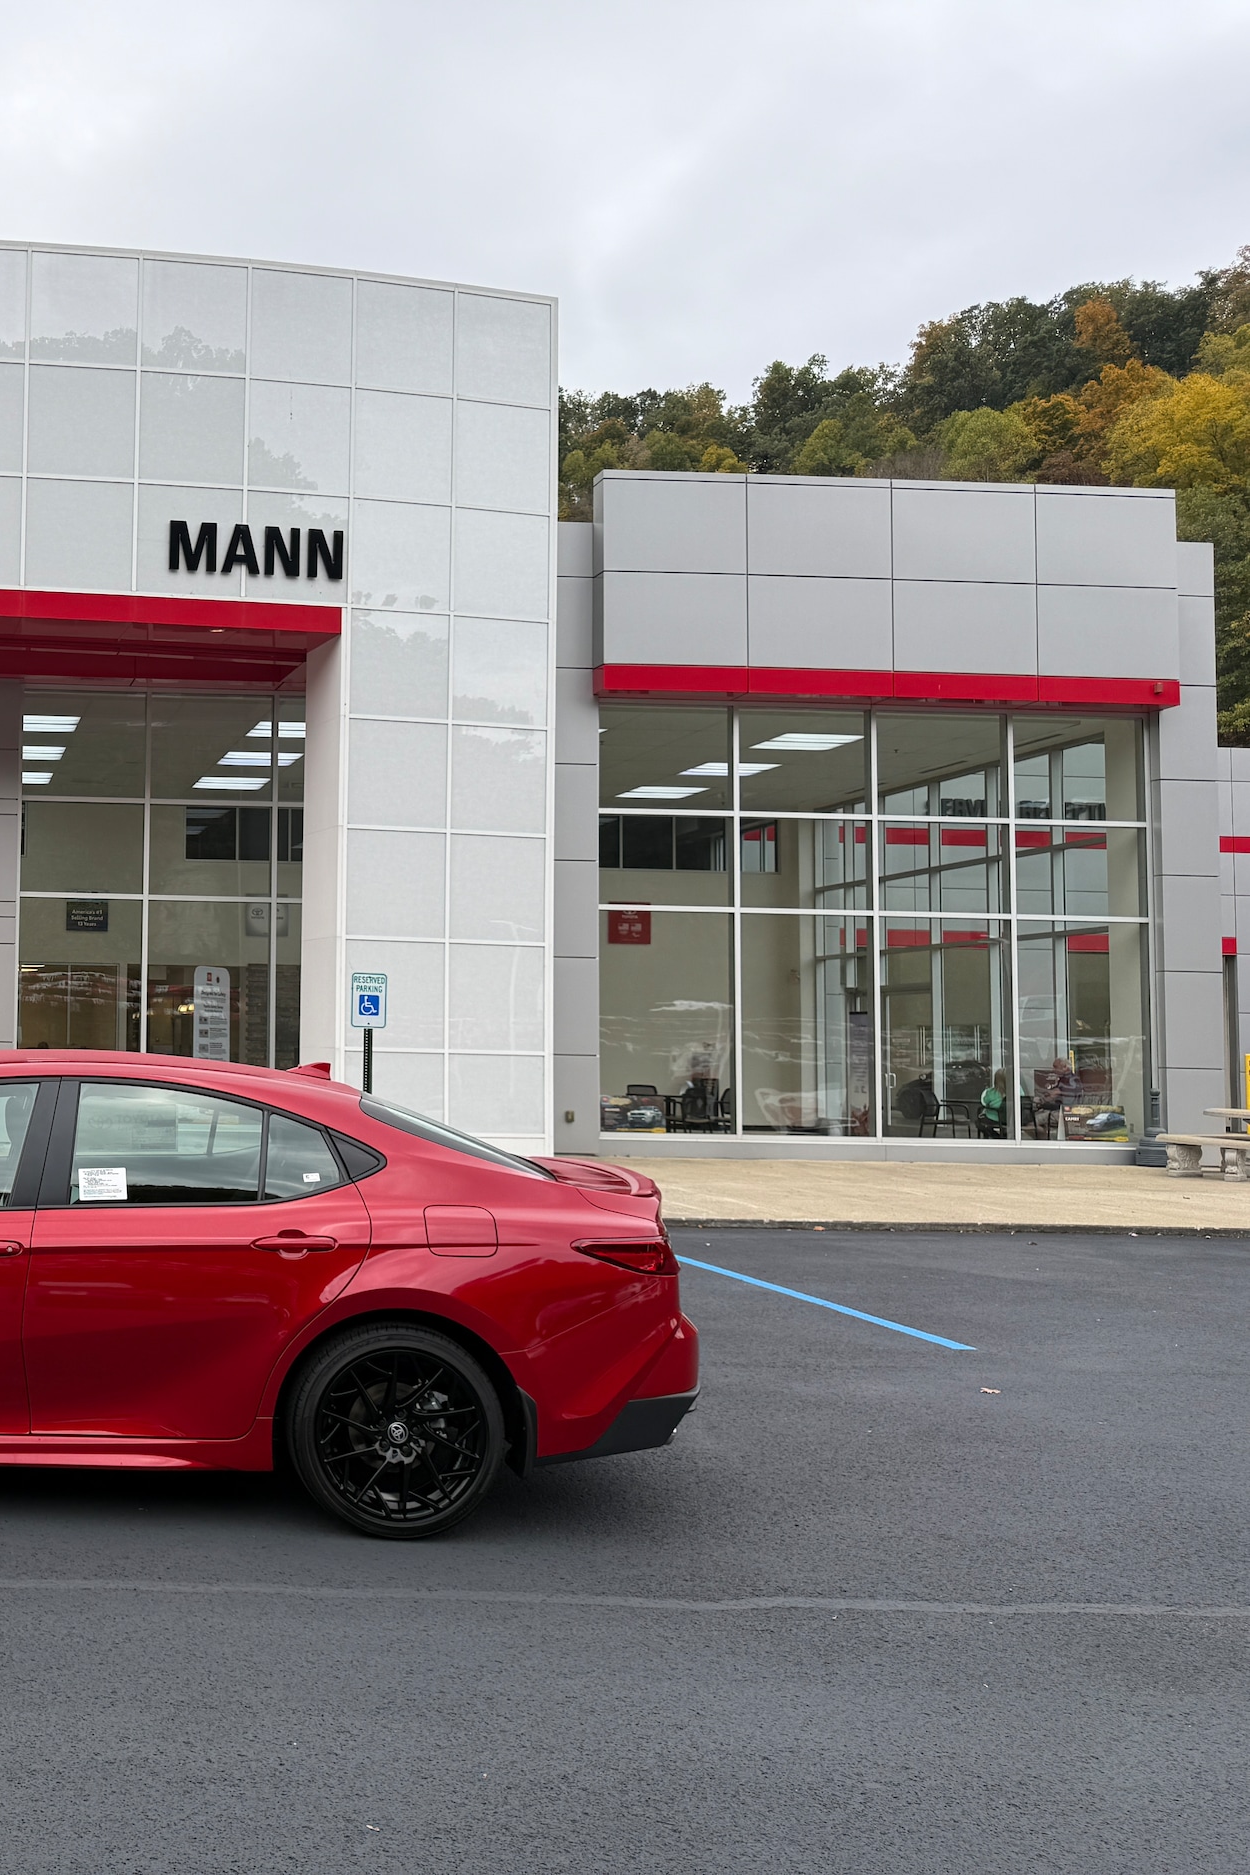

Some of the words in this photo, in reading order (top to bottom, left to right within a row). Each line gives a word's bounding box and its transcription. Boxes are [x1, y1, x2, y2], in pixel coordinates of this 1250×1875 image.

[169, 520, 344, 580] MANN
[353, 976, 385, 984] RESERVED
[356, 985, 382, 993] PARKING
